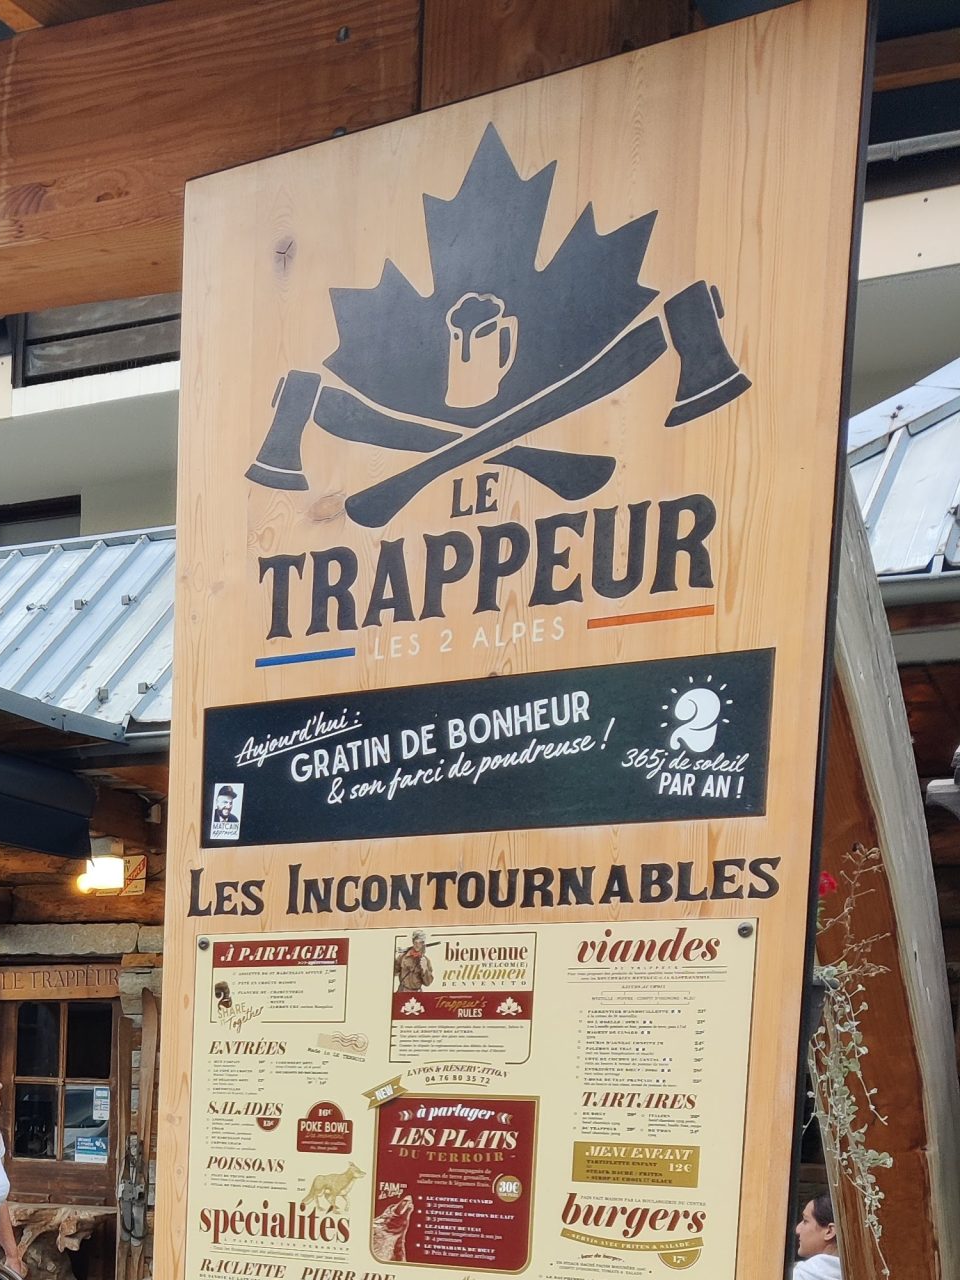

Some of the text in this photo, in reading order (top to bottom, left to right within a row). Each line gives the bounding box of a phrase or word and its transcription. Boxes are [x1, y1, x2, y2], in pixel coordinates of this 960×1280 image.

[450, 472, 500, 518] LE
[258, 494, 717, 640] TRAPPEUR
[374, 617, 565, 660] LES 2 ALPES
[234, 708, 348, 768] Aujourd'hui
[291, 690, 590, 783] GRATIN DE BONHEUR
[327, 777, 345, 805] &
[350, 778, 386, 800] son
[387, 759, 445, 802] farci
[448, 751, 476, 780] de
[473, 733, 596, 785] poudreuse
[622, 748, 749, 780] 365j de soleil
[658, 772, 693, 797] PAR
[701, 775, 732, 799] AN
[237, 944, 339, 961] PARTAGER
[445, 942, 528, 961] bienvenue
[577, 927, 721, 964] viandes
[0, 967, 119, 991] LE TRAPPEUR
[458, 1008, 483, 1018] RULES
[208, 1038, 288, 1056] ENTRÉES
[207, 1101, 284, 1117] SALADES
[582, 1092, 698, 1110] TARTARES
[427, 1104, 495, 1126] partager
[300, 1121, 349, 1133] POKE BOWL
[390, 1127, 519, 1150] LES PLATS
[206, 1156, 285, 1172] POISSONS
[399, 1148, 504, 1163] DU TERROIR
[585, 1146, 693, 1160] MENU ENFANT
[669, 1163, 692, 1172] 12€
[500, 1182, 519, 1193] 30€
[199, 1199, 350, 1244] spécialités
[561, 1192, 706, 1238] burgers
[200, 1258, 287, 1279] RACLETTE
